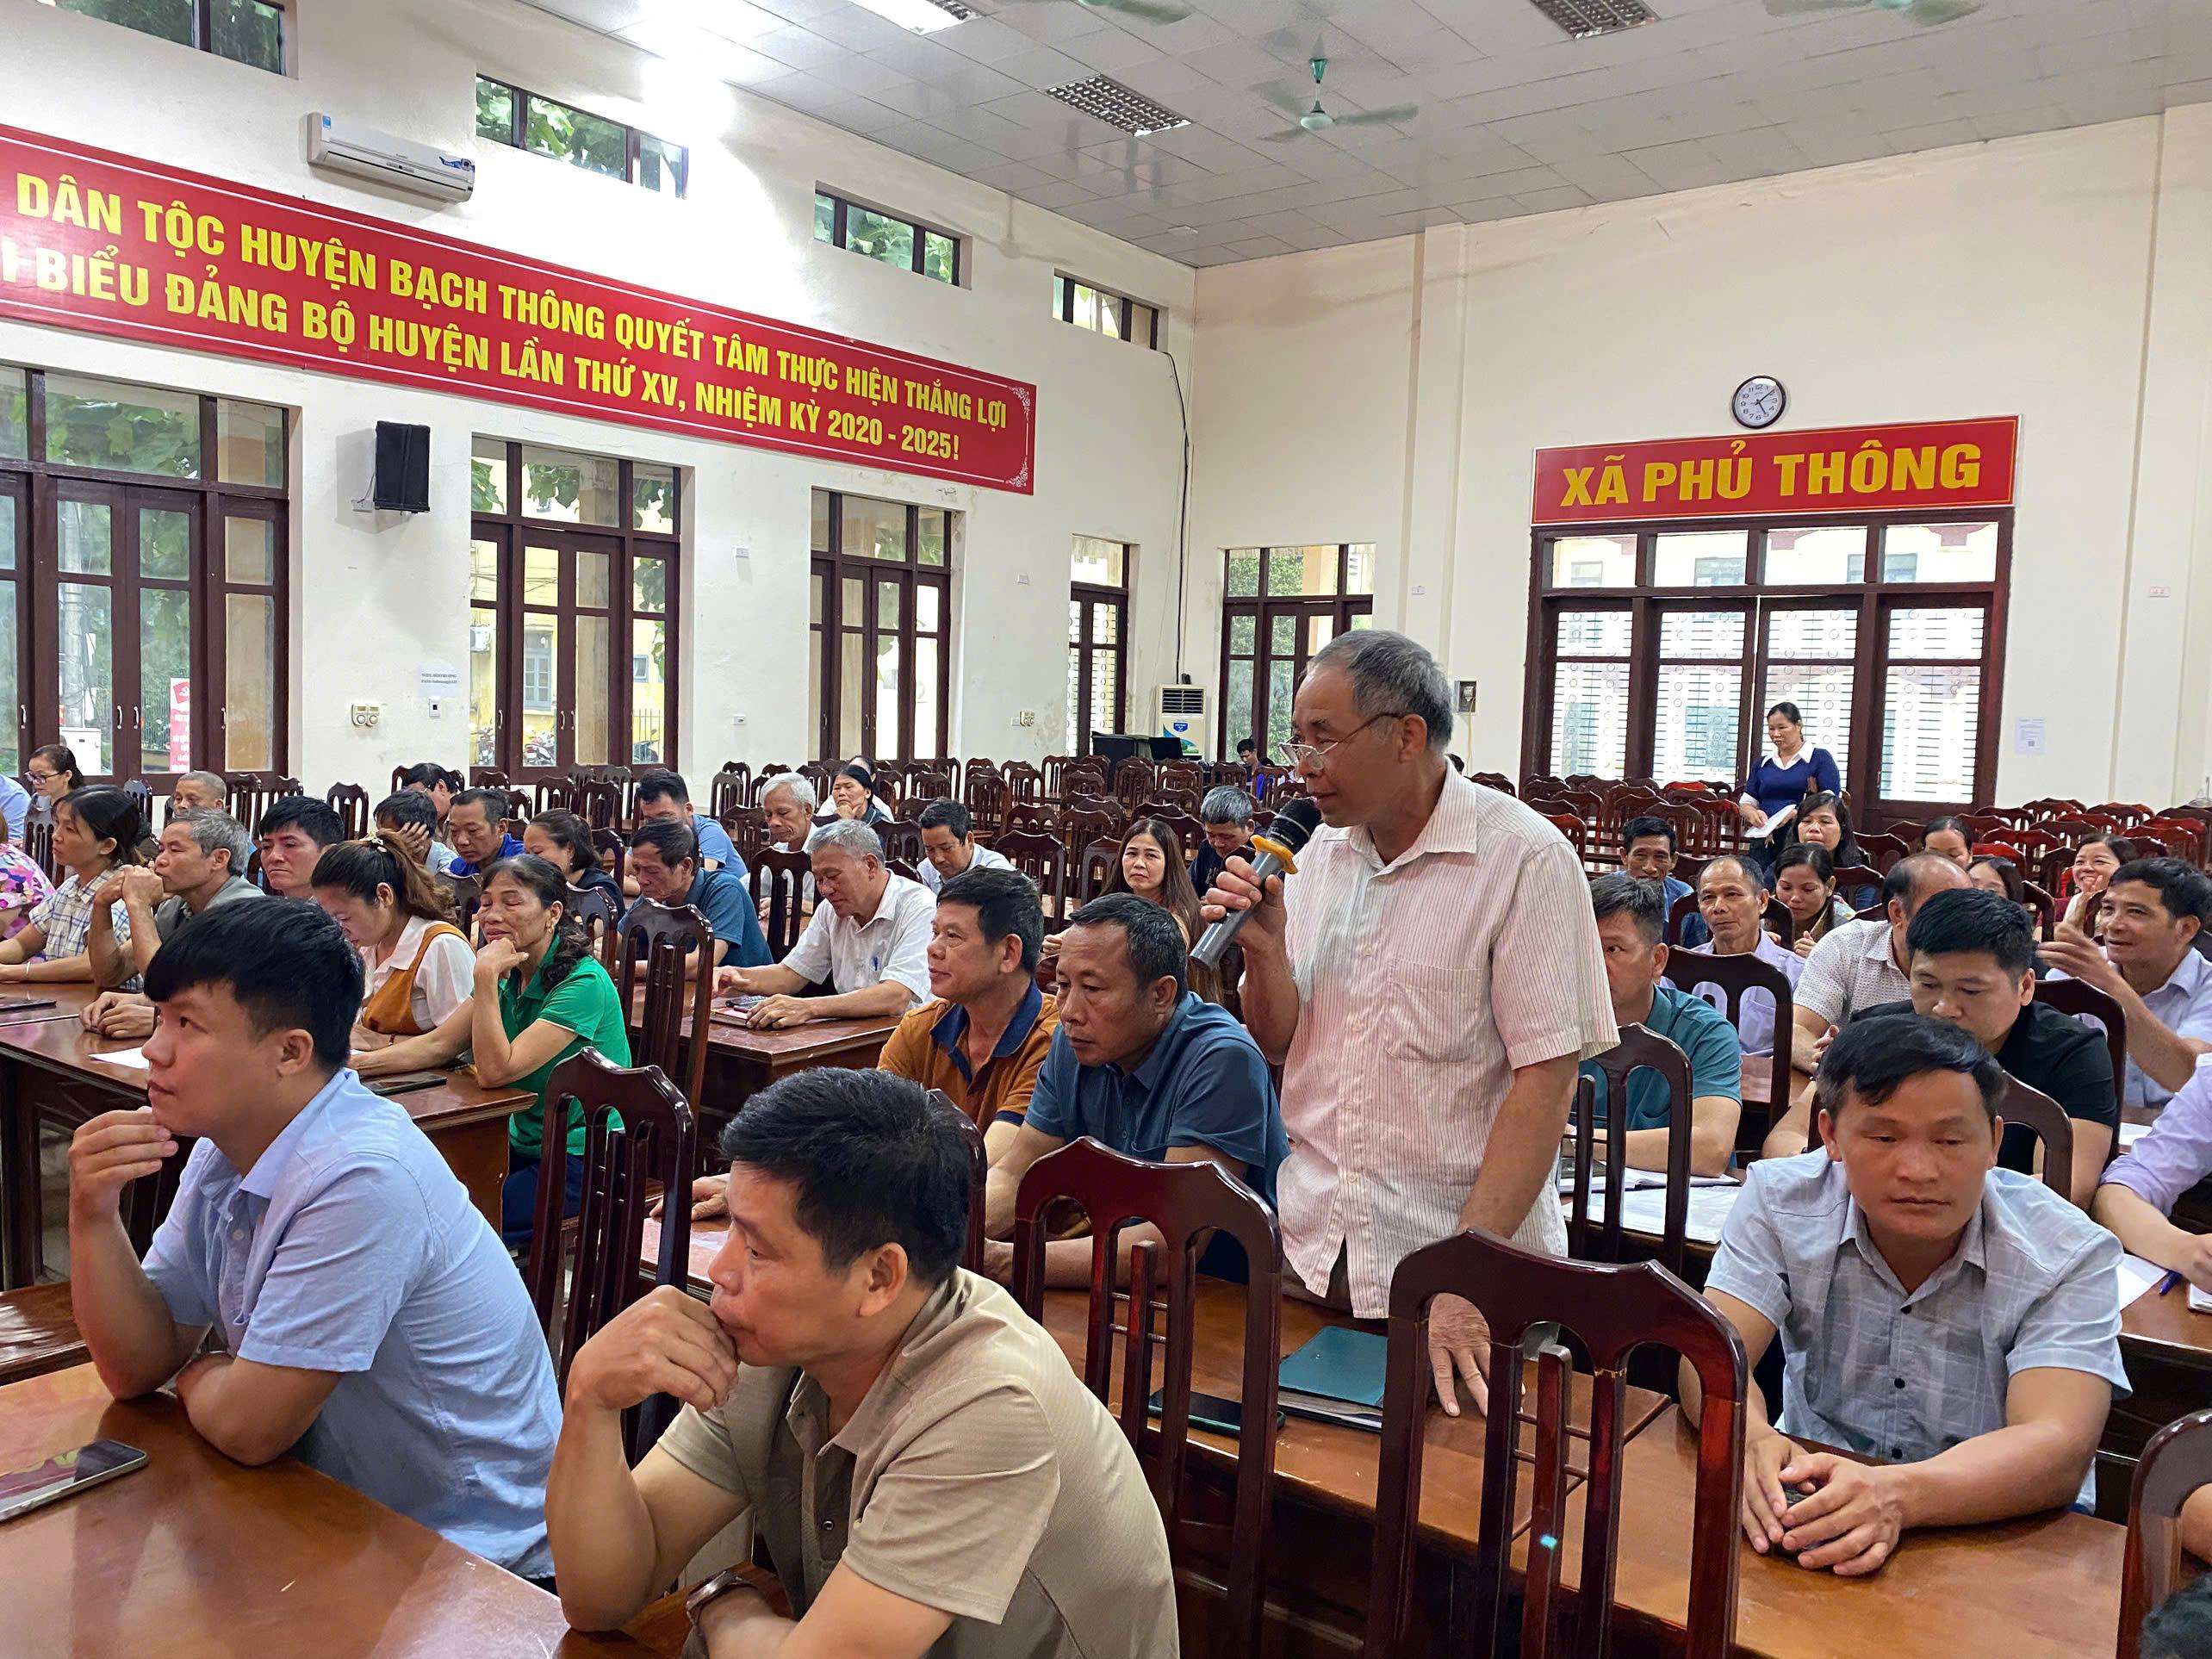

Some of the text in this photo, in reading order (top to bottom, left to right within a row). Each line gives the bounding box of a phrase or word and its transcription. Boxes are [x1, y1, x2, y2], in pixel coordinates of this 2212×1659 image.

[16, 172, 1007, 432] DÂN TỘC HUYỆN BẠCH THÔNG QUYẾT TÂM THỰC HIỆN THẮNG LỢI
[36, 245, 149, 307] BIỂU
[165, 264, 288, 333] ĐẢNG
[302, 301, 355, 353] BỘ
[370, 314, 488, 372] HUYỆN
[500, 337, 564, 386] LẦN
[574, 356, 637, 398] THỨ
[640, 370, 687, 412] XV,
[695, 381, 781, 427] NHIỆM
[789, 397, 821, 434] KỲ
[827, 409, 883, 446] 2020
[902, 425, 960, 460] 2025!
[1560, 439, 1981, 507] XÃ PHỦ THÔNG
